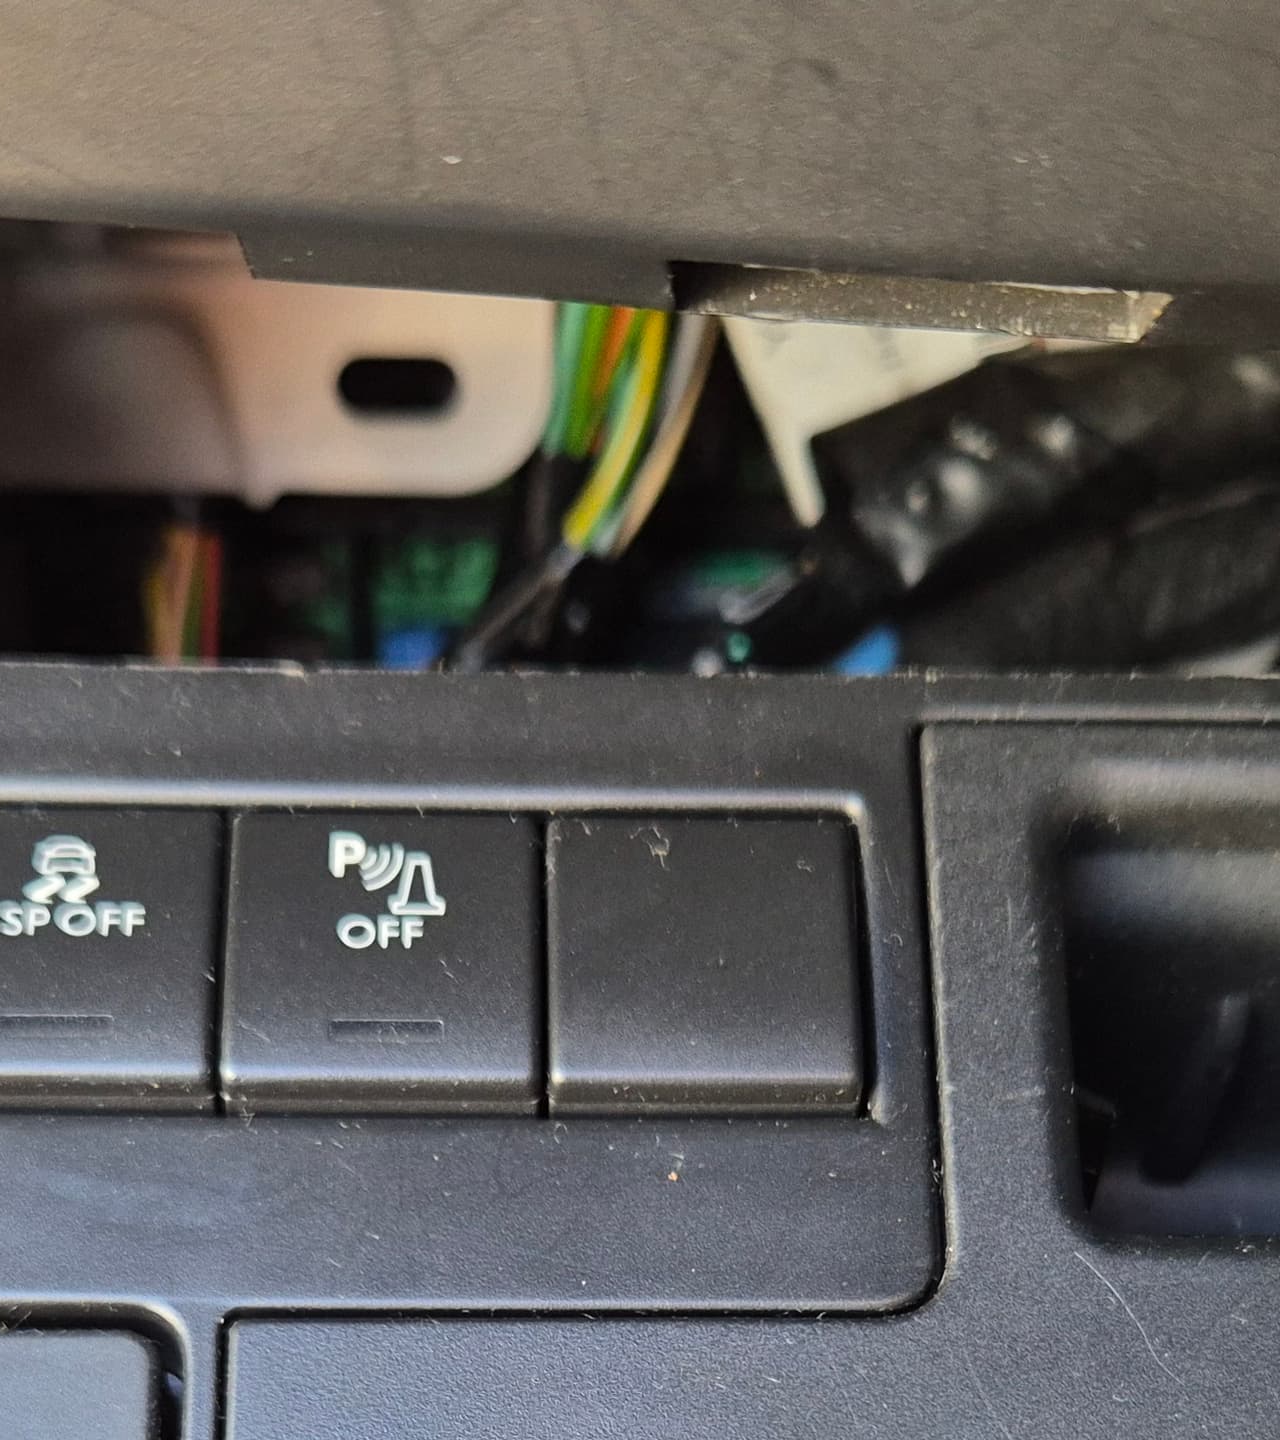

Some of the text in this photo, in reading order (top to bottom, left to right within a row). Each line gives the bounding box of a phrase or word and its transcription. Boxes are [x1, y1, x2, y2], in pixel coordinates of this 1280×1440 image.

[328, 830, 366, 878] P
[53, 901, 146, 937] OFF
[336, 913, 424, 949] OFF
